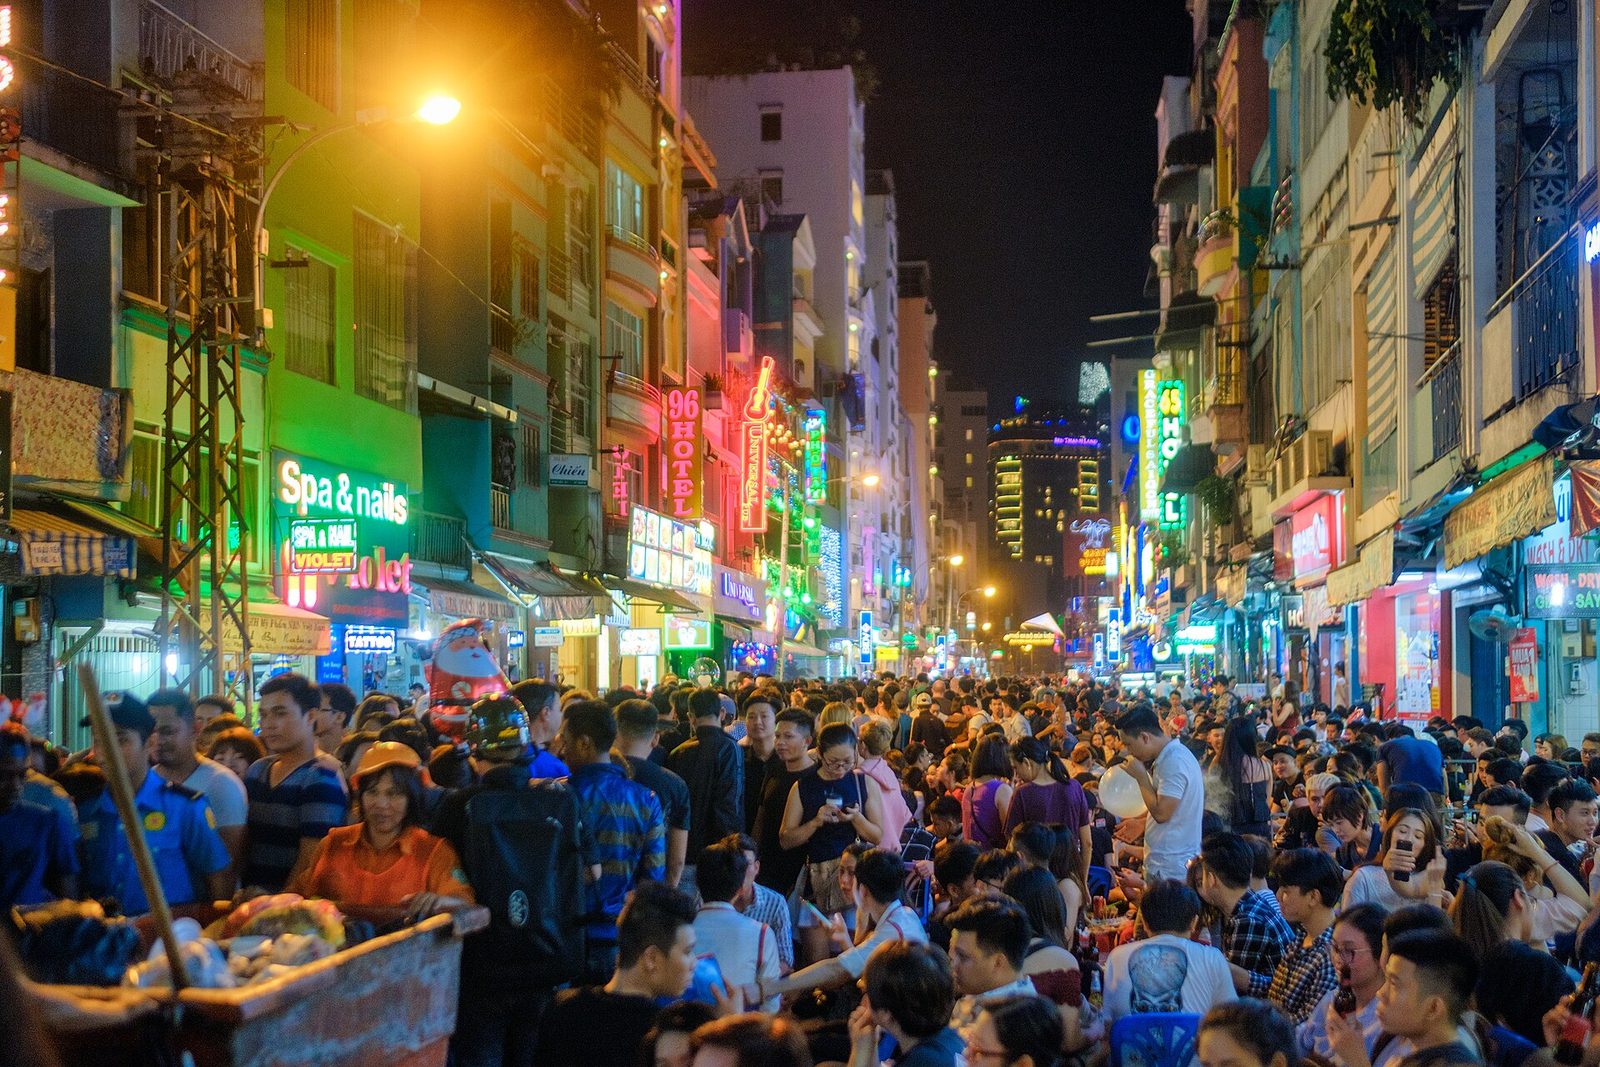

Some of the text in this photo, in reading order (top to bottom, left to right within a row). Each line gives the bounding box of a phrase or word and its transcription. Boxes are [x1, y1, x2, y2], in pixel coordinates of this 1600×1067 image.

[668, 389, 699, 420] 96
[1159, 388, 1181, 416] 65
[551, 463, 586, 476] Chiến
[671, 421, 696, 516] HOTEL
[748, 423, 763, 503] UNIVERSAL
[1161, 417, 1182, 522] HOL
[280, 460, 408, 525] Spa & nails
[294, 524, 355, 548] SPA & NAIL
[1558, 537, 1565, 563] &
[295, 552, 354, 568] VIOLET
[326, 546, 414, 595] olet
[721, 572, 756, 604] UNIVERSAL
[1535, 573, 1568, 588] WASH
[347, 635, 392, 649] TATTOO
